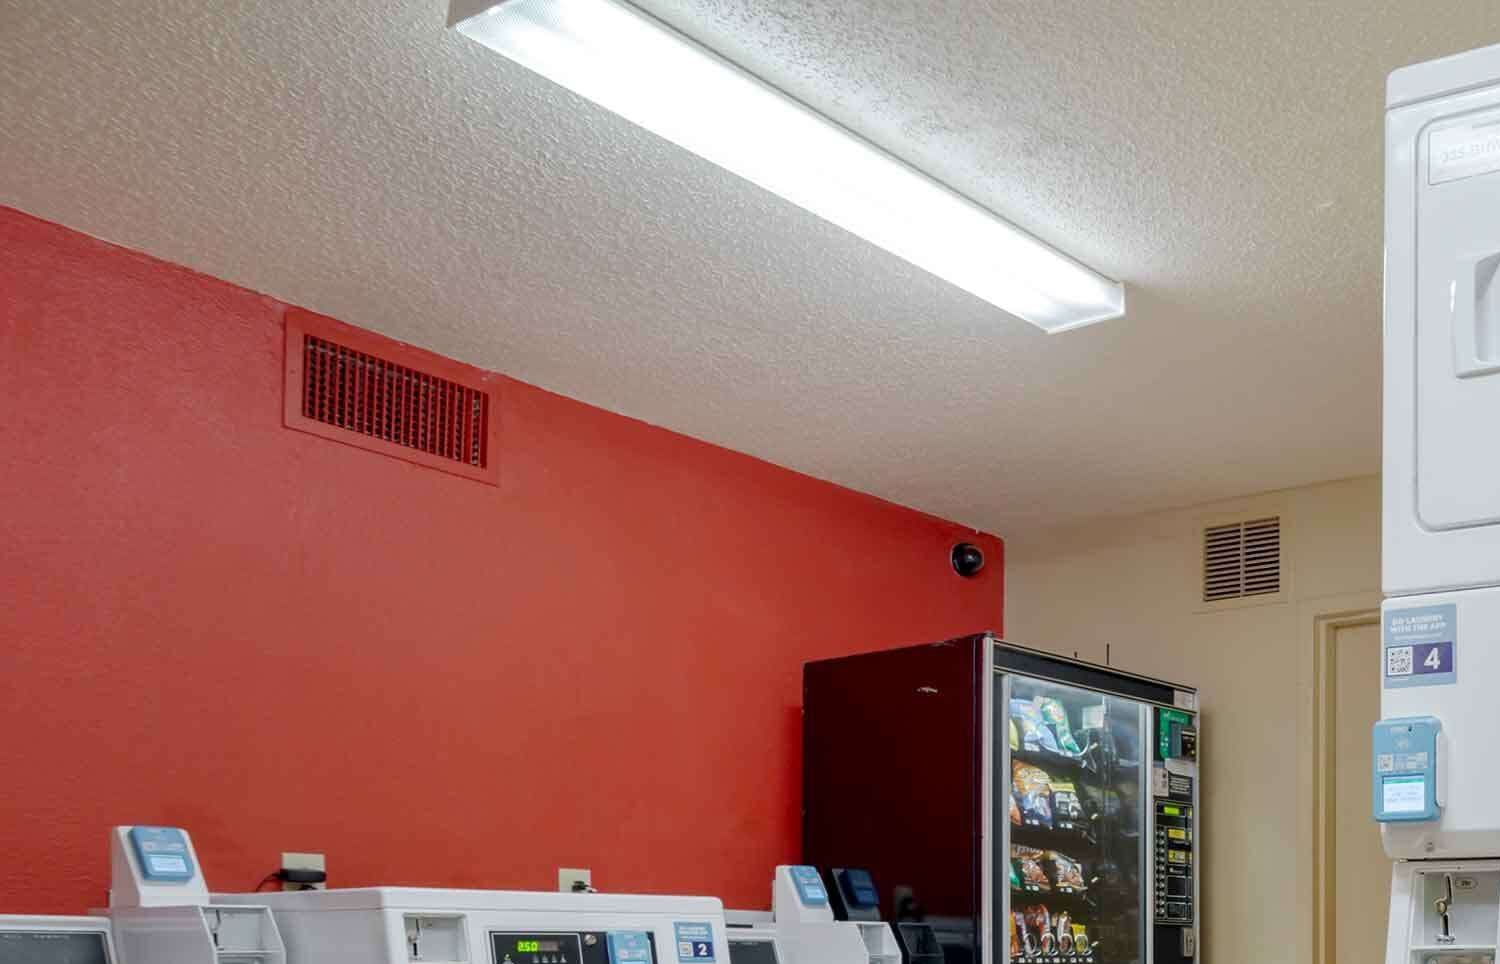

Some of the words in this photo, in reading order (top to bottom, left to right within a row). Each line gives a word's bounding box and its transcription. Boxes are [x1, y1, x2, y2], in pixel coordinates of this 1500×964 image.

[1408, 614, 1442, 625] LAUNDRY
[1424, 648, 1440, 670] 4
[698, 944, 709, 956] 2
